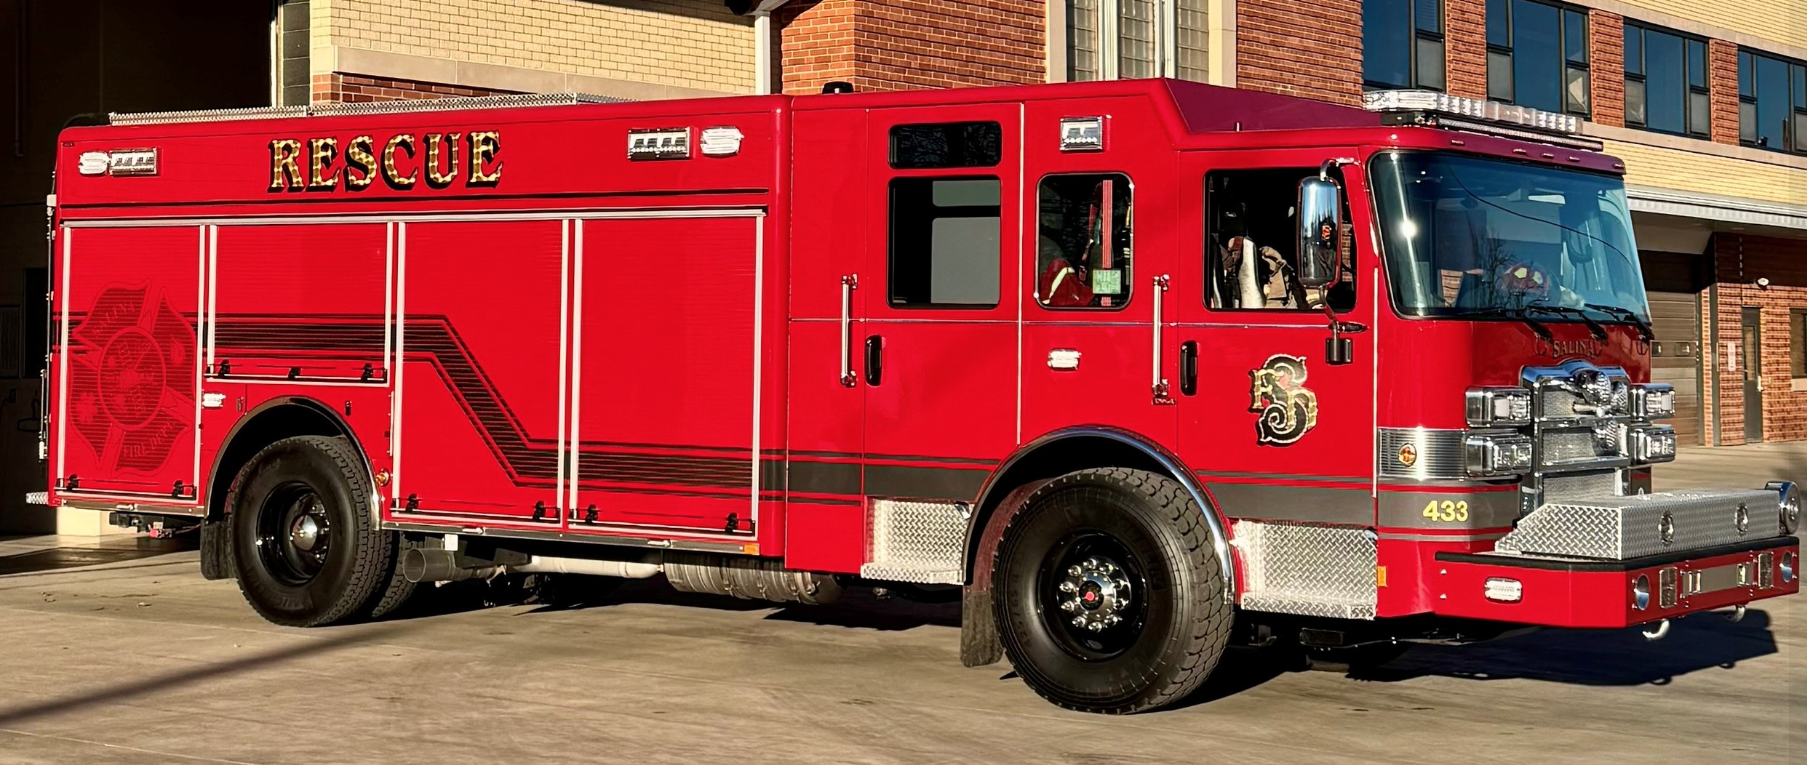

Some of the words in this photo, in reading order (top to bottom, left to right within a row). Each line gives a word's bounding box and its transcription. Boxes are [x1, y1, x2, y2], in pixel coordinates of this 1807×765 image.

[268, 131, 503, 193] RESCUE
[1553, 340, 1598, 359] SALINA
[1423, 500, 1468, 522] 433
